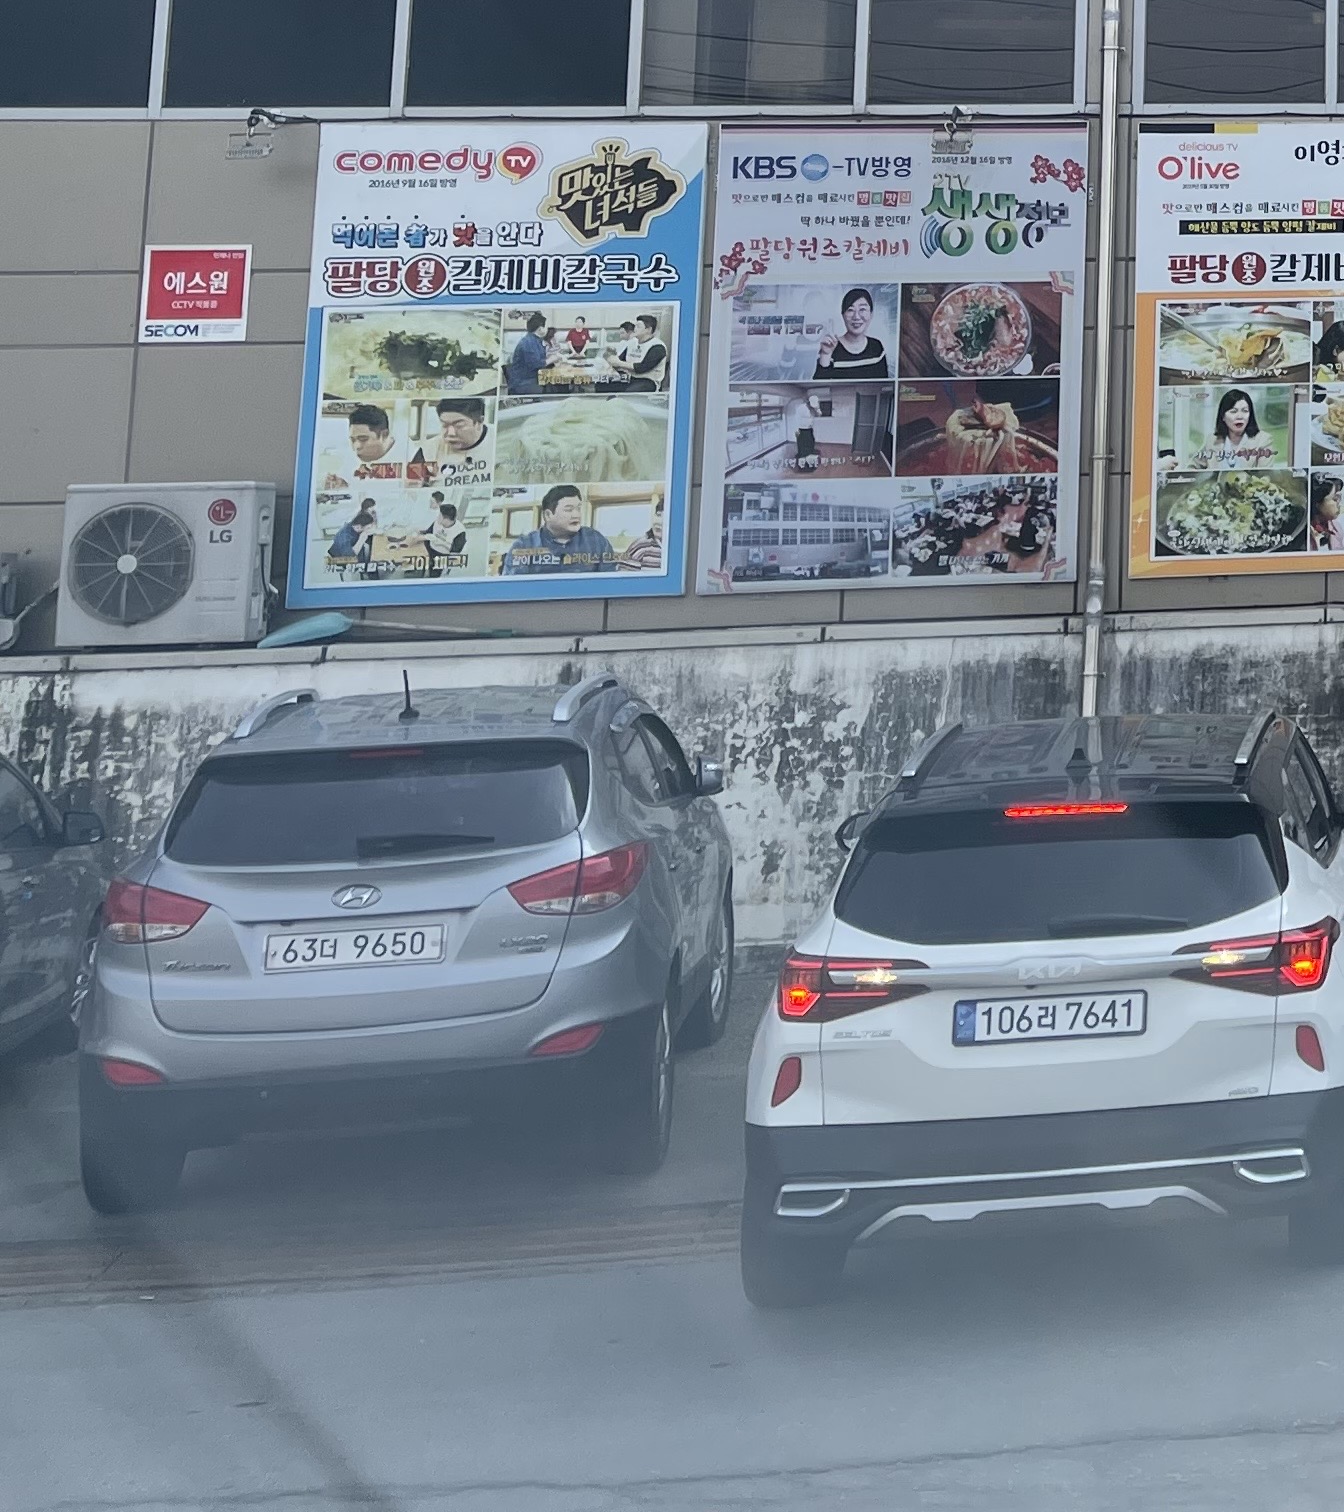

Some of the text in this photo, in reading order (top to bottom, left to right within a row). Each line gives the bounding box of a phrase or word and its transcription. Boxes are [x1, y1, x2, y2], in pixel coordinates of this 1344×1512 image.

[334, 144, 532, 181] comedy TV
[732, 156, 797, 179] KBS
[559, 163, 634, 209] 맛있는
[584, 177, 659, 231] 녀석들
[496, 221, 543, 247] 안다
[163, 271, 229, 295] 에스원
[327, 259, 403, 294] 팔당
[450, 255, 679, 293] 칼제비칼국수
[1168, 254, 1230, 284] 팔당
[145, 324, 199, 337] SECOM
[209, 530, 232, 544] LG
[353, 931, 426, 960] 9650
[1066, 998, 1135, 1031] 7641
